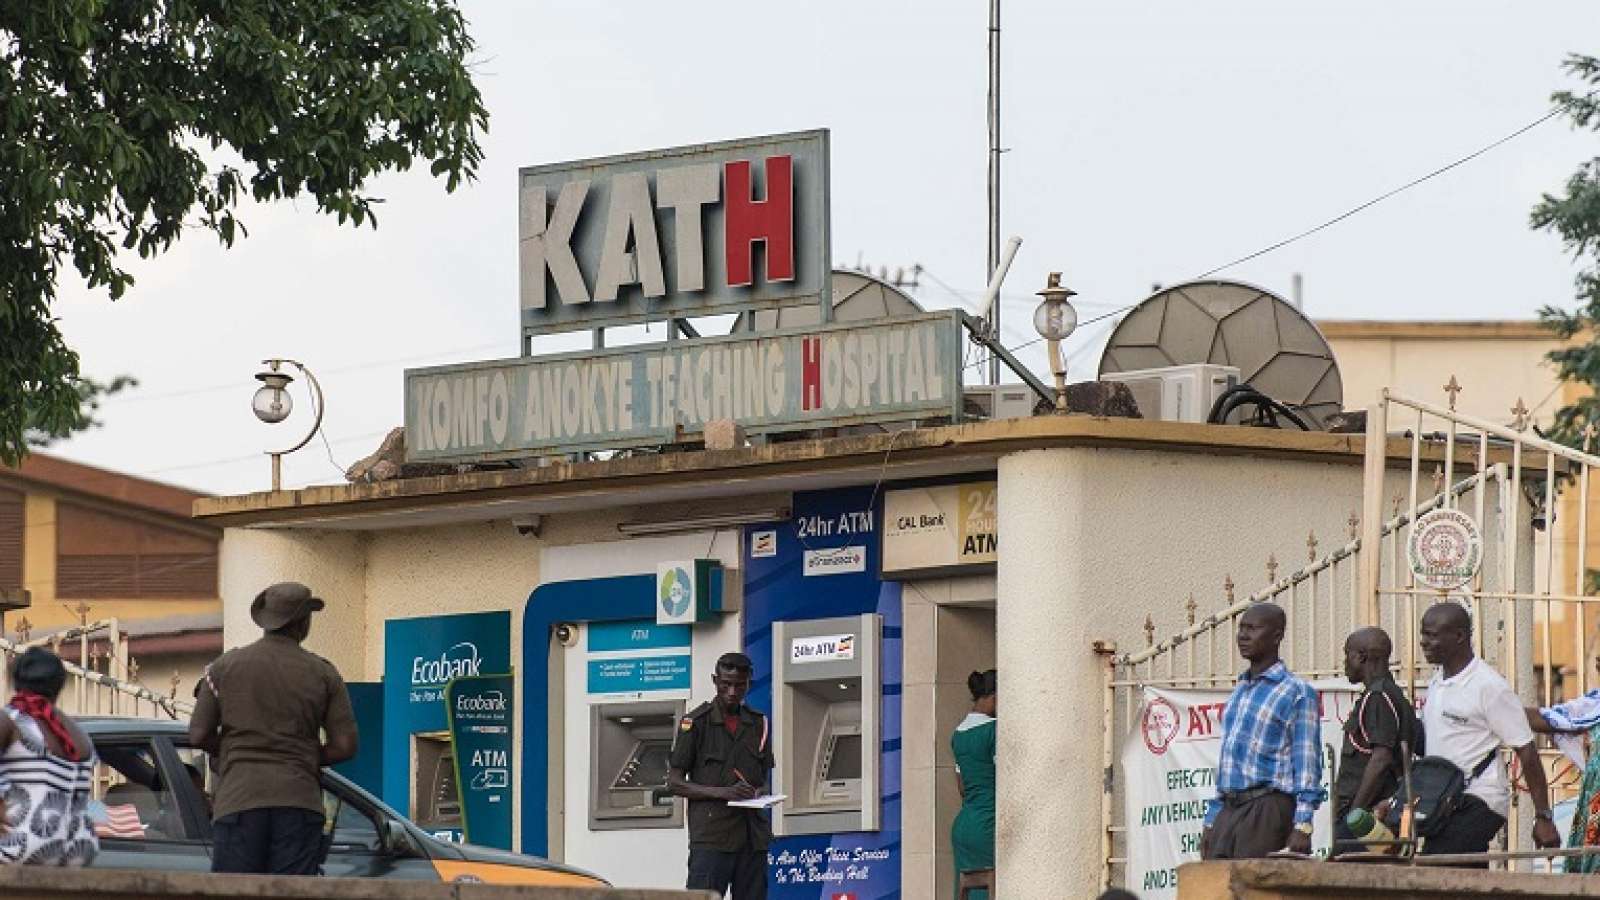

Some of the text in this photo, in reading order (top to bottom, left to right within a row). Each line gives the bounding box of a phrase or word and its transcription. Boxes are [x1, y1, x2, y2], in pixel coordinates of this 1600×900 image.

[520, 154, 795, 310] KATH
[523, 359, 633, 442] ANOKYE
[646, 341, 786, 428] TEACHING
[801, 326, 943, 412] HOSPITAL
[798, 514, 834, 538] 24hr
[837, 509, 873, 534] ATM
[898, 514, 944, 530] CAL Bank
[794, 644, 814, 658] 24hr
[815, 641, 836, 656] ATM
[411, 642, 482, 684] Ecobank
[456, 690, 507, 711] Ecobank
[471, 749, 507, 767] ATM
[1141, 804, 1164, 826] ANY
[798, 848, 823, 868] Offer
[825, 847, 851, 862] These
[852, 846, 890, 861] Services
[808, 866, 844, 885] Banking
[846, 864, 869, 880] Hall
[1143, 868, 1168, 891] AND
